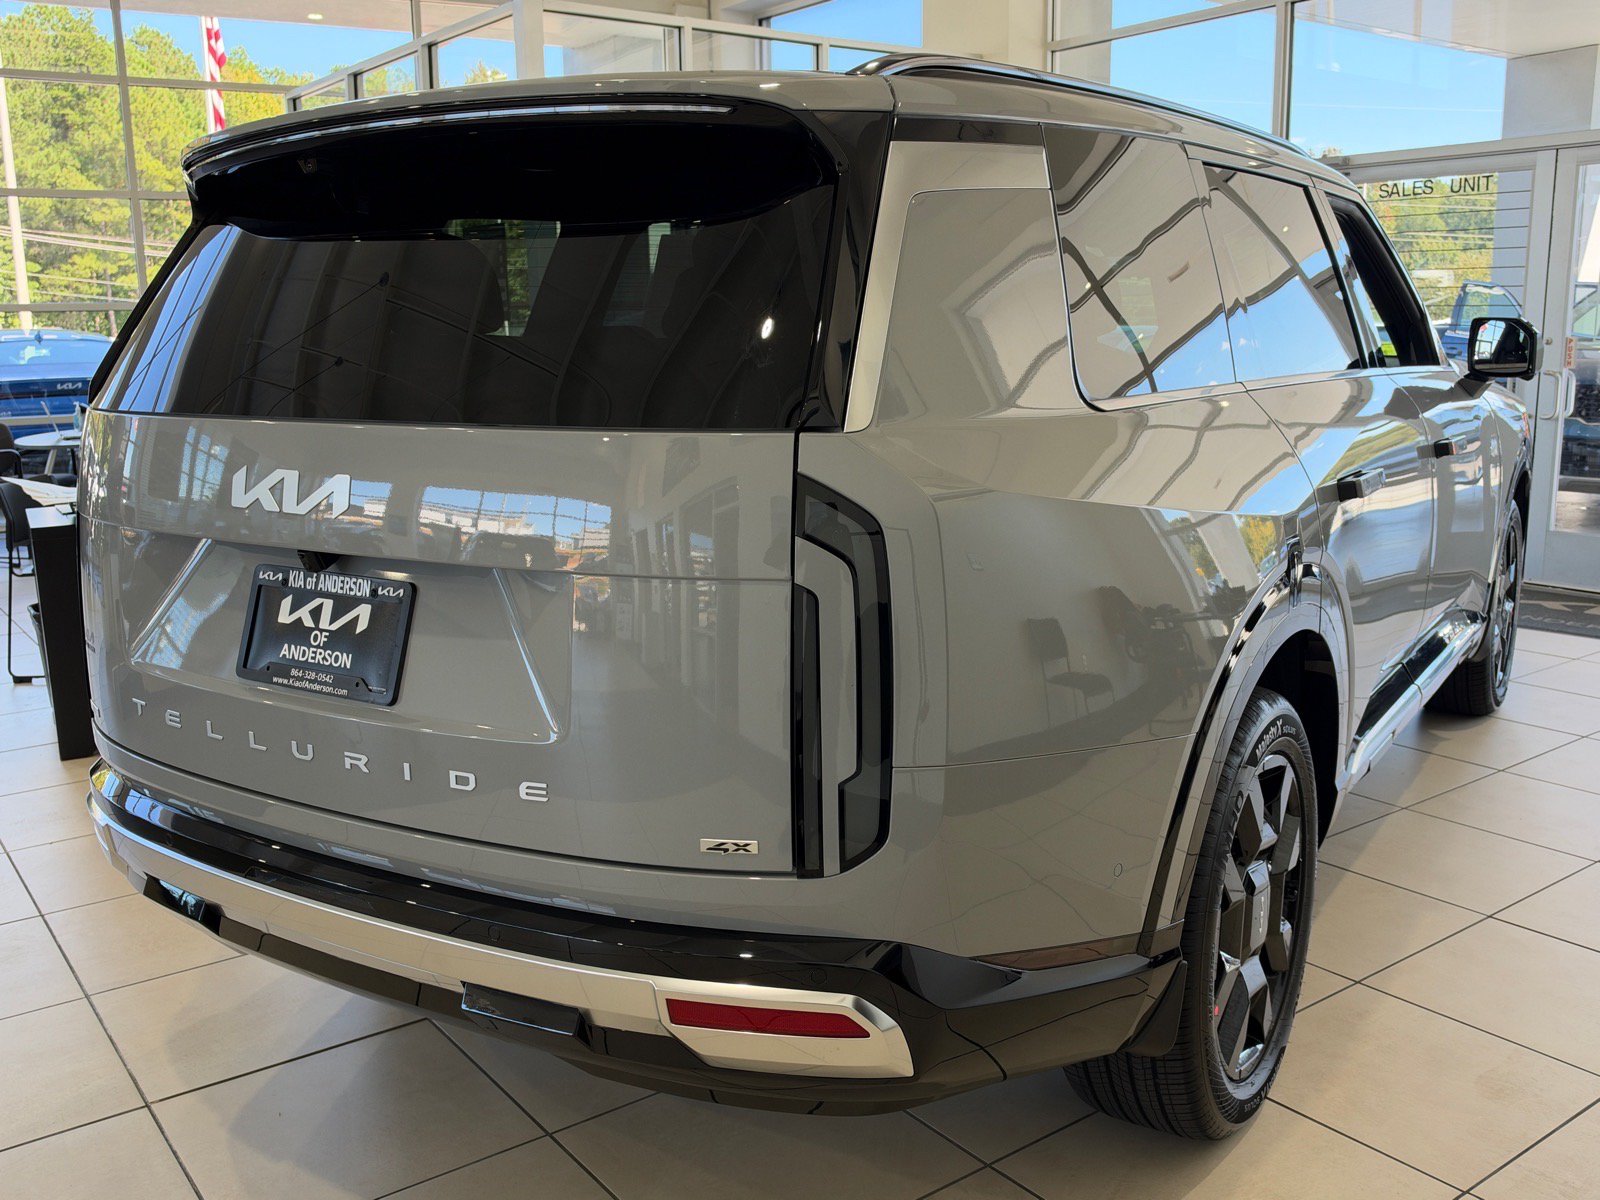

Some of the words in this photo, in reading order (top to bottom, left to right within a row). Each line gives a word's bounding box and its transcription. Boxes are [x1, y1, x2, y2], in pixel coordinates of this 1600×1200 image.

[1378, 179, 1434, 198] SALES
[1450, 175, 1494, 194] UNIT
[231, 464, 350, 519] KIA
[288, 570, 304, 589] KIA
[306, 573, 317, 590] of
[317, 573, 371, 597] ANDERSON
[277, 594, 372, 635] KIA
[310, 630, 329, 647] OF
[279, 643, 352, 669] ANDERSON
[272, 676, 348, 696] www.KiaofAnderson.com
[290, 668, 334, 683] 864-328-0542
[132, 698, 549, 802] TELLURIDE
